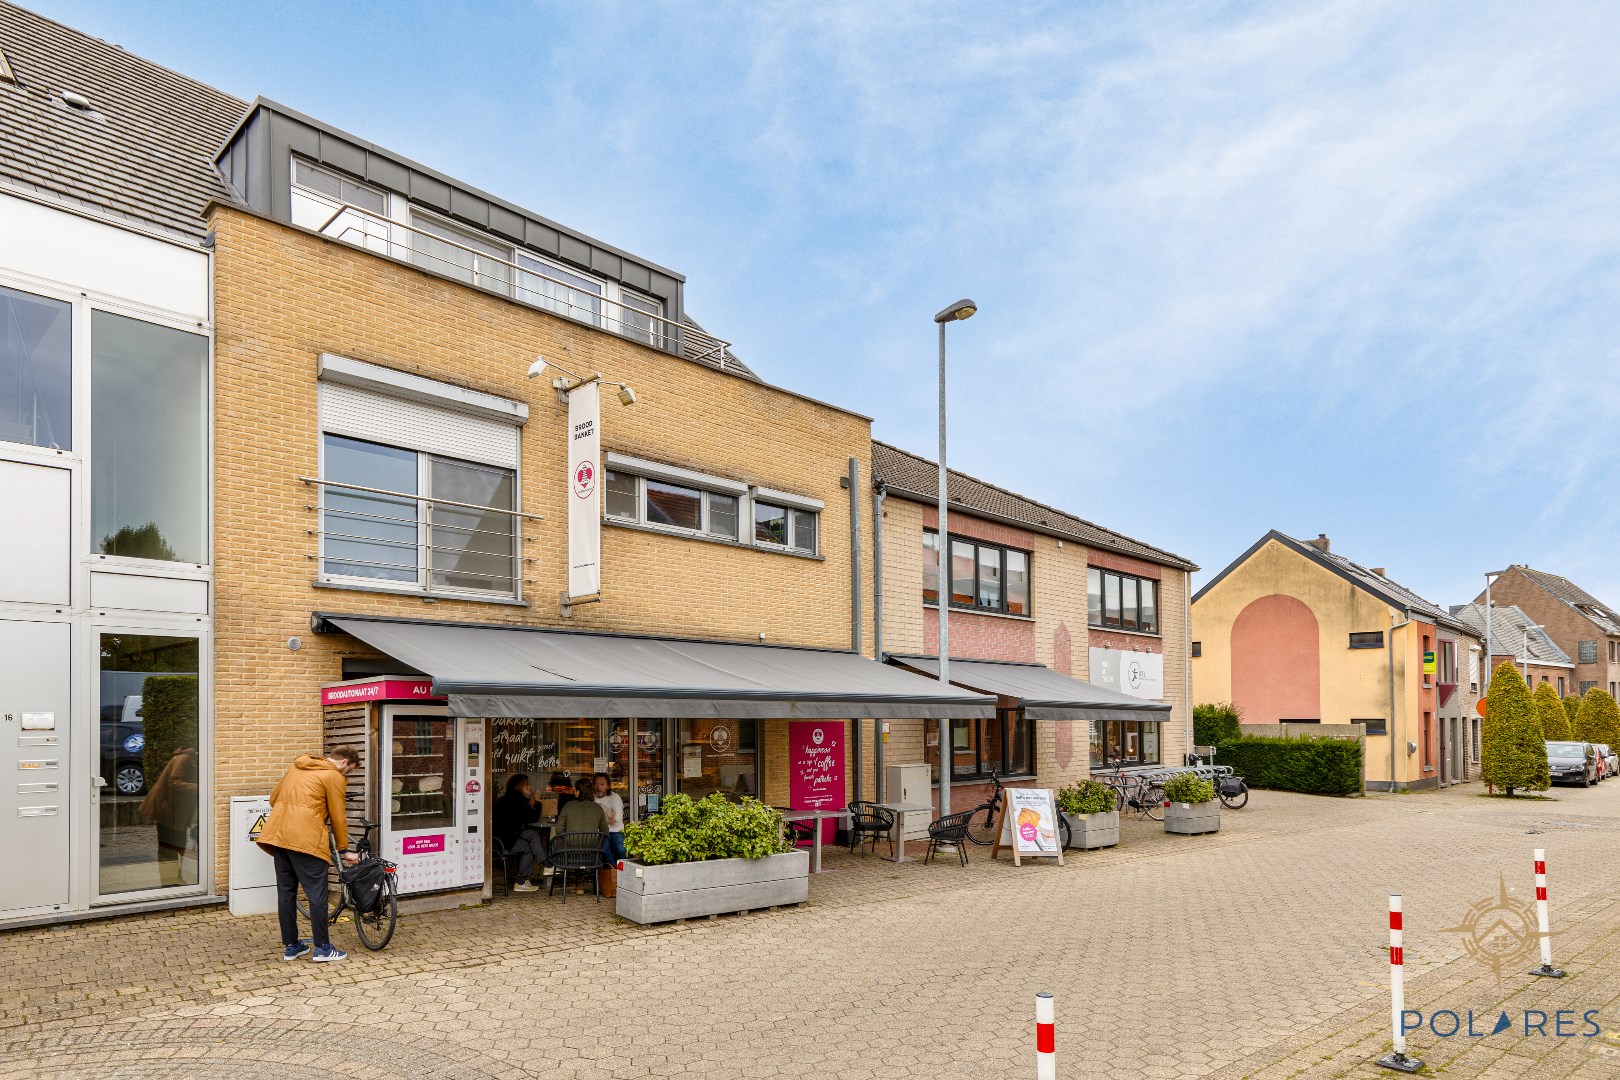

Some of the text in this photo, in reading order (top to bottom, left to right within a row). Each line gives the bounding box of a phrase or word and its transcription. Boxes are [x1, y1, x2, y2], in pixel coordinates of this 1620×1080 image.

[575, 420, 592, 432] BROOD
[574, 428, 594, 440] BANKET
[328, 686, 379, 700] BROODAUTOMAAT 24/7
[412, 686, 426, 694] AU
[818, 756, 835, 771] coffee
